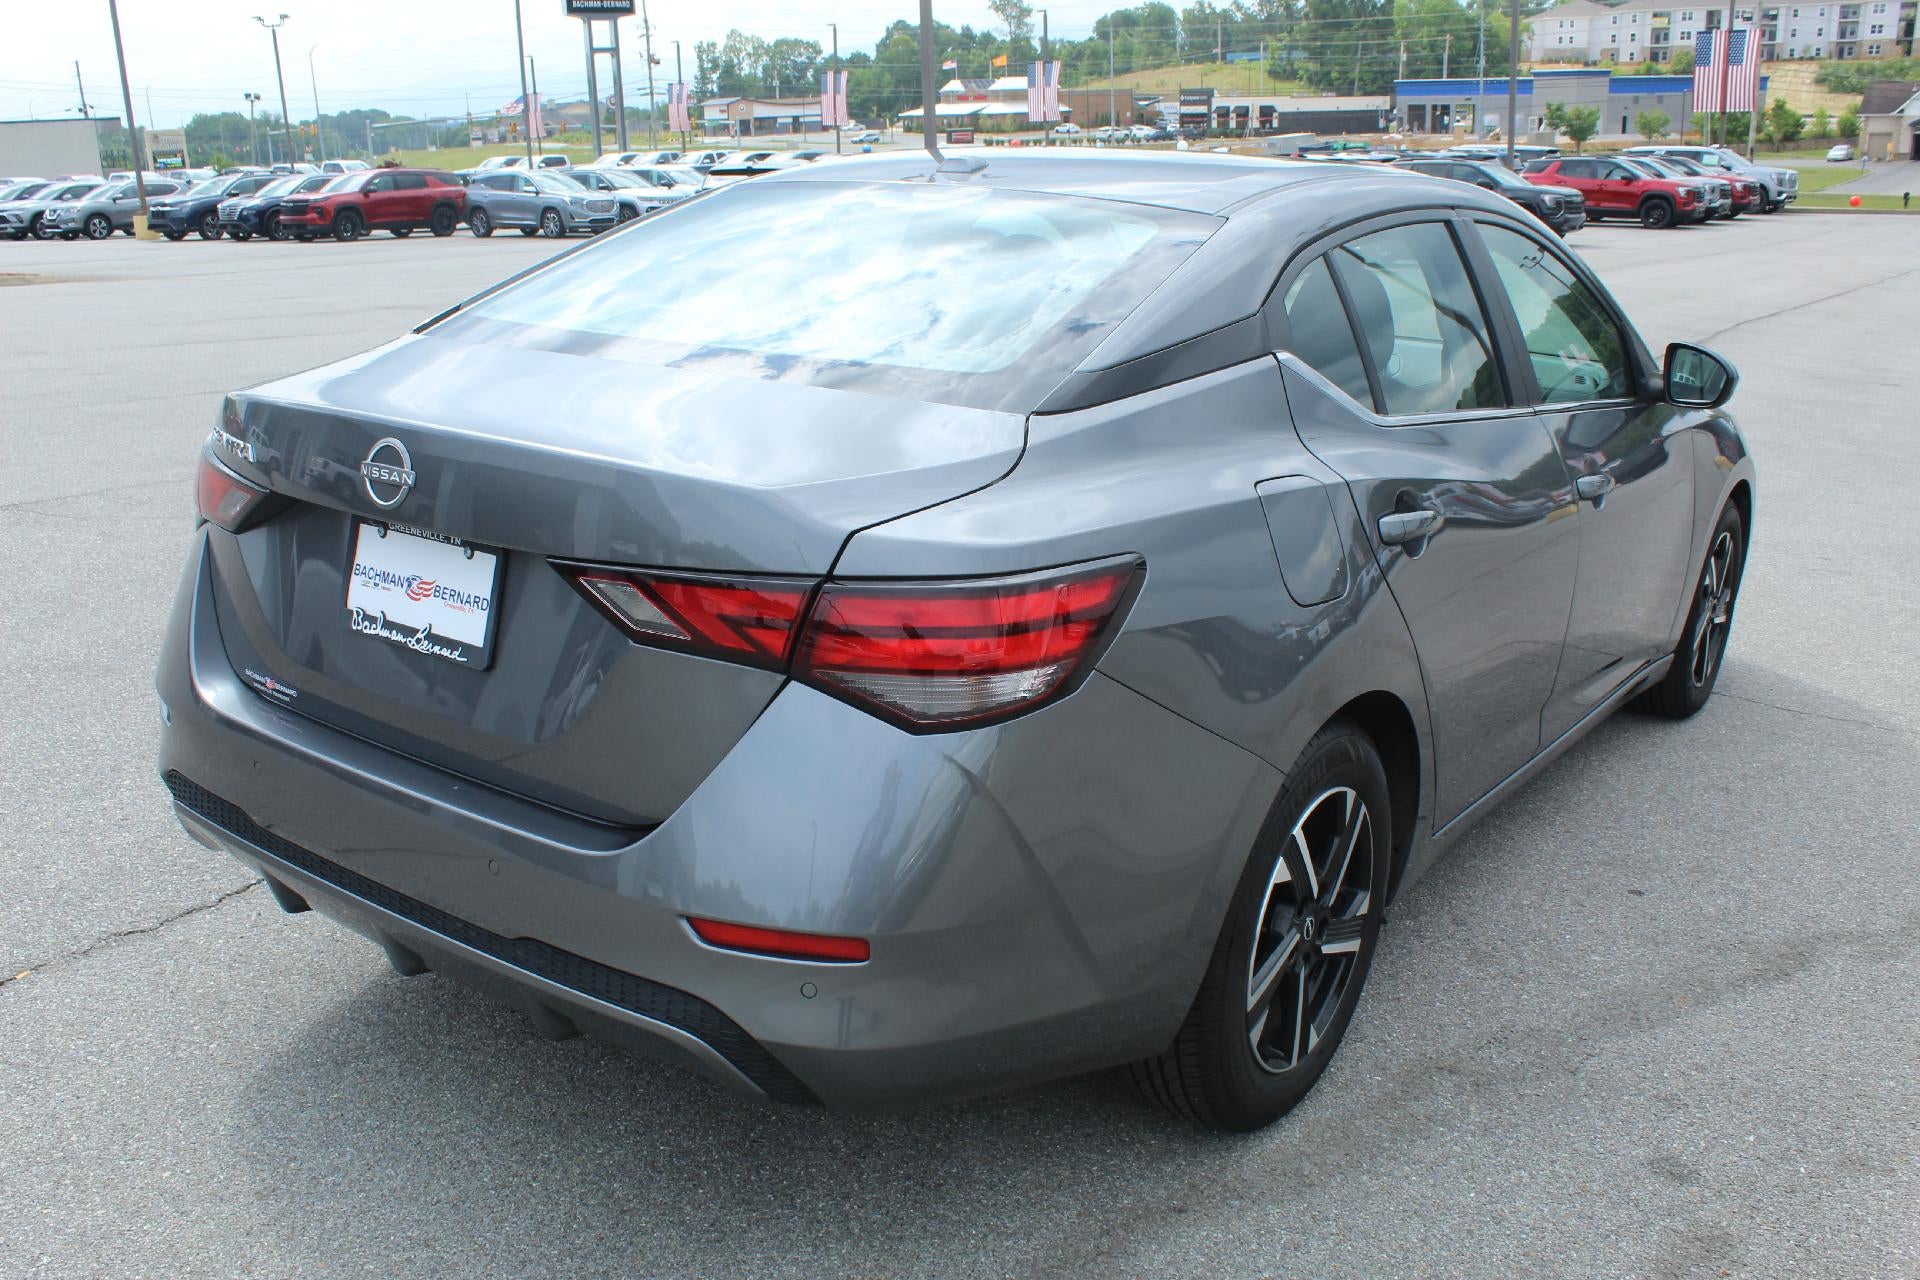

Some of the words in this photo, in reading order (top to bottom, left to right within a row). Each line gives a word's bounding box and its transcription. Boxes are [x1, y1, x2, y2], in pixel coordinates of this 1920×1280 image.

[360, 463, 413, 485] NISSAN
[388, 522, 448, 543] GREENEVILLE,
[449, 535, 461, 545] TN
[353, 562, 405, 589] BACHMAN
[433, 584, 490, 612] BERNARD
[351, 606, 407, 644] Bachman
[406, 623, 467, 661] Bernard
